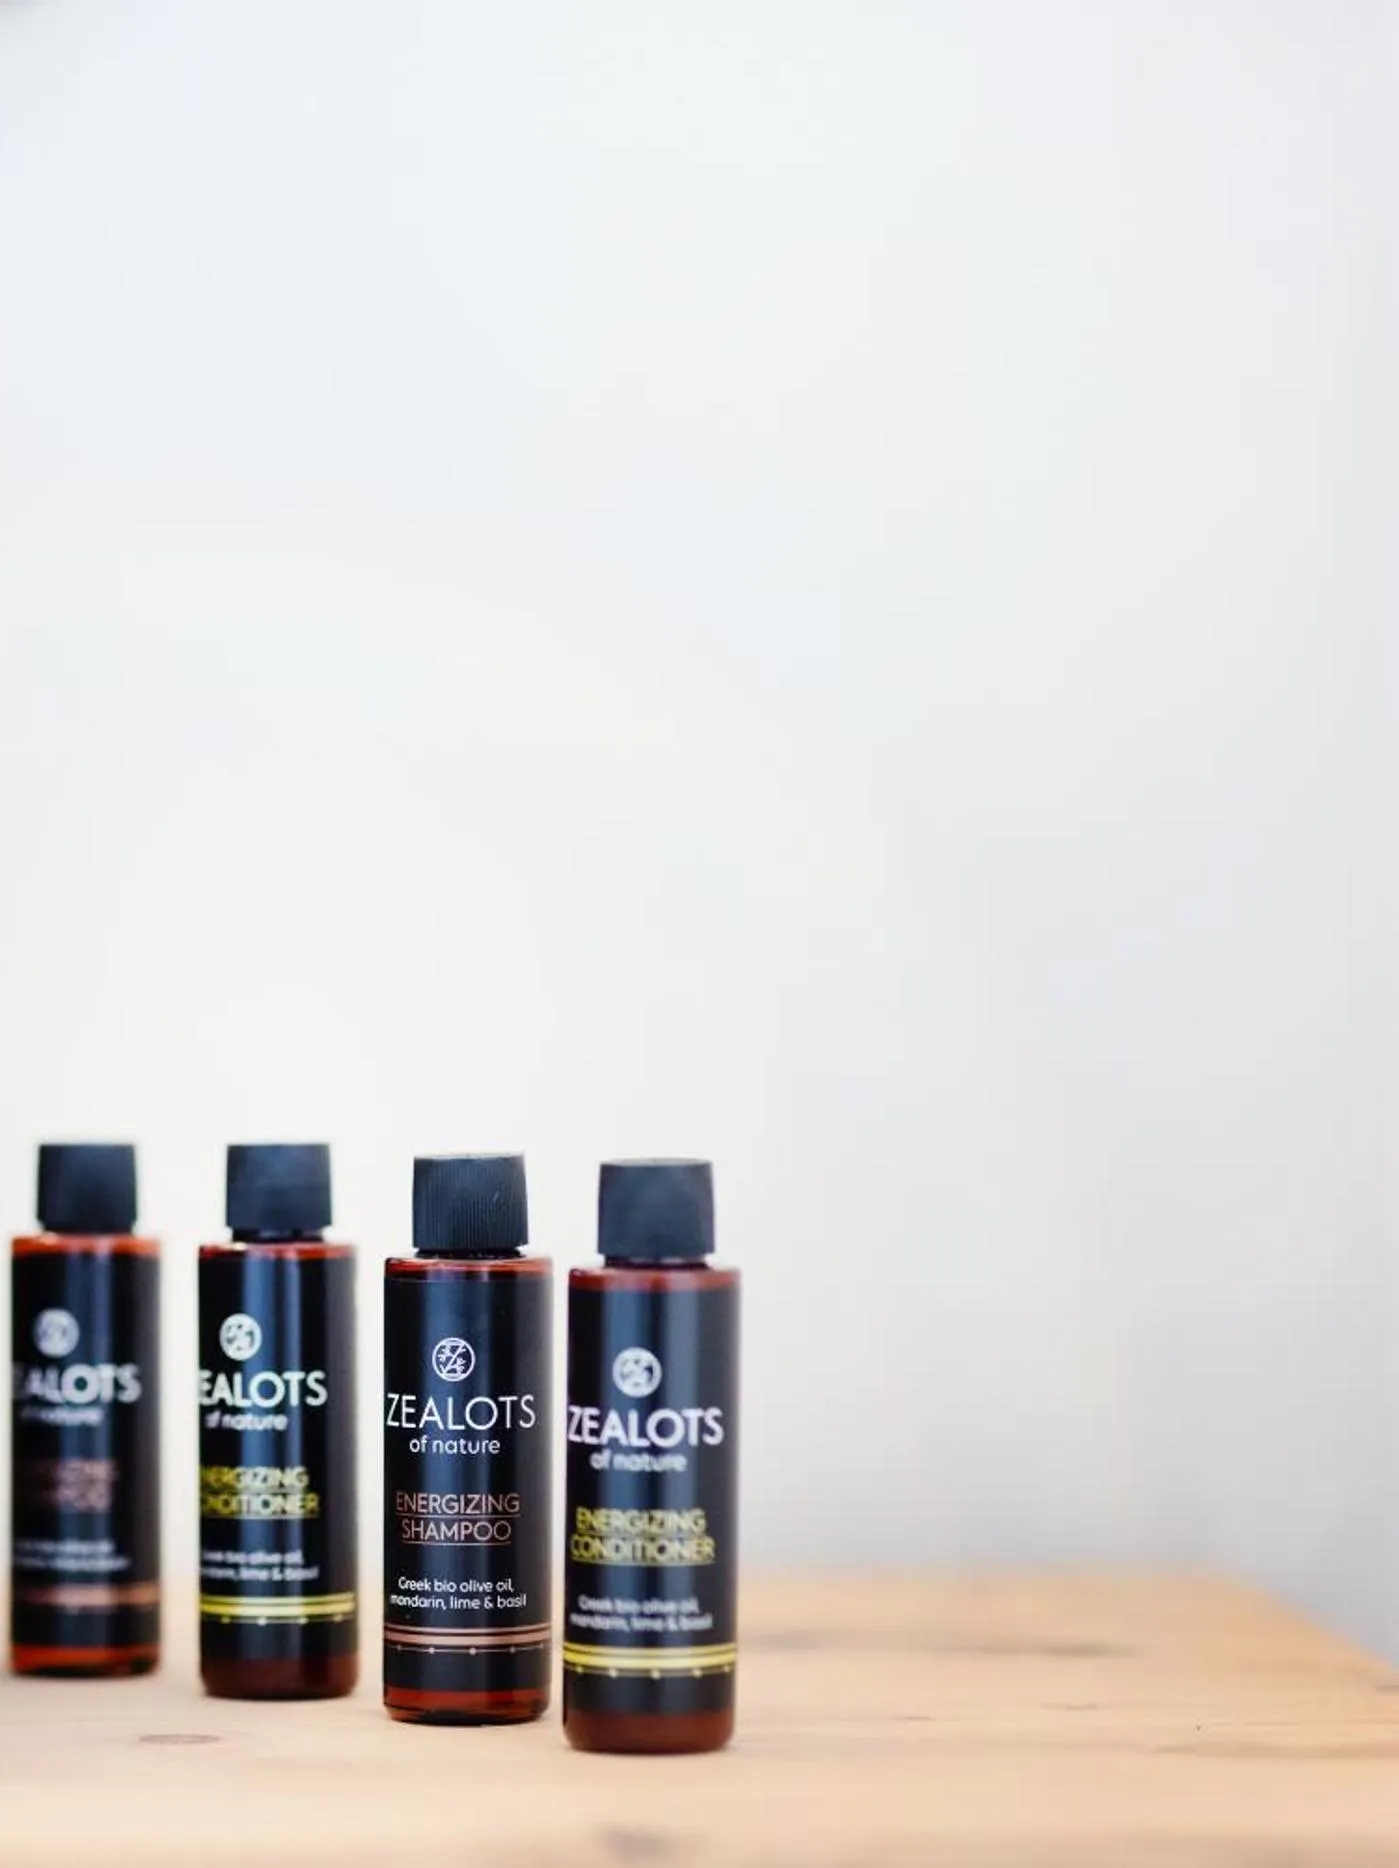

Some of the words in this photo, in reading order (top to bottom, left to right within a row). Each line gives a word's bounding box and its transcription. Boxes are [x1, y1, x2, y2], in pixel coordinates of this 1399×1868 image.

[198, 1369, 328, 1408] EALOTS
[386, 1393, 536, 1431] ZEALOTS
[568, 1405, 725, 1448] ZEALOTS
[409, 1435, 428, 1454] of
[431, 1438, 501, 1455] nature
[589, 1448, 612, 1470] of
[613, 1452, 688, 1473] nature
[396, 1492, 520, 1515] ENERGIZING
[402, 1519, 512, 1542] SHAMPOO
[575, 1507, 708, 1533] ENERGIZING
[570, 1533, 716, 1562] CONDITIONER
[398, 1576, 432, 1592] Greek
[434, 1577, 457, 1593] bio
[459, 1578, 493, 1593] olive
[390, 1594, 446, 1611] mandarin,
[450, 1595, 481, 1610] lime
[483, 1596, 494, 1610] &
[497, 1593, 527, 1609] basil
